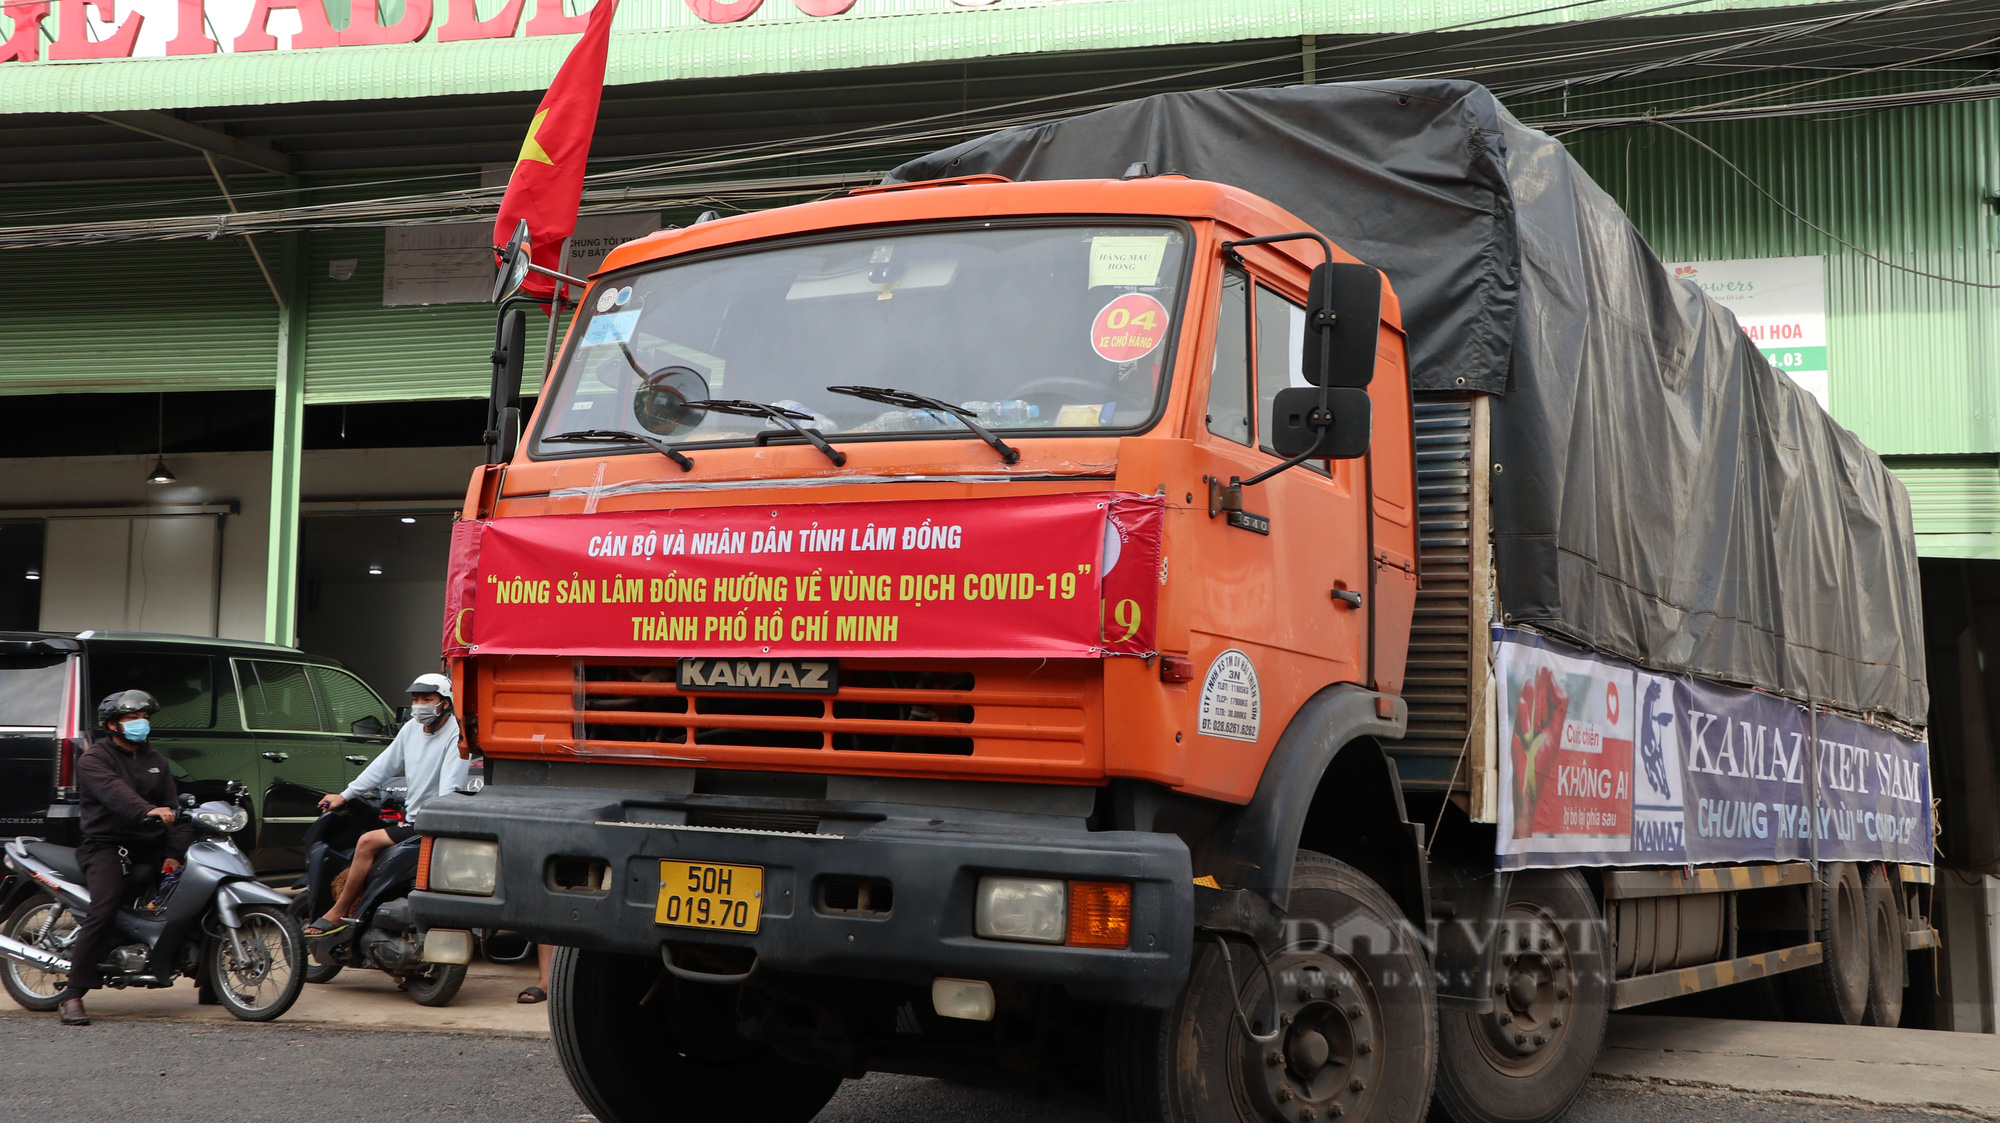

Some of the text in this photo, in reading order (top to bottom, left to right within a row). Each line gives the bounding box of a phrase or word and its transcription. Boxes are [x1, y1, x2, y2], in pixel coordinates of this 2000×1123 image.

[1107, 308, 1157, 330] 04
[1770, 324, 1802, 339] HOA
[1098, 336, 1110, 348] XE
[588, 518, 962, 561] CÁN BỘ VÀ NHÂN DÂN TỈNH LÂM ĐỒNG
[487, 574, 551, 604] “NÔNG
[555, 571, 597, 604] SẢN
[602, 573, 644, 603] LÂM
[649, 569, 707, 603] ĐỒNG
[713, 571, 788, 602] HƯỚNG
[795, 567, 822, 602] VỀ
[830, 569, 892, 602] VÙNG
[899, 574, 955, 607] DỊCH
[631, 606, 899, 642] THÀNH PHỐ HỒ CHÍ MINH
[681, 660, 831, 689] KAMAZ
[1228, 670, 1241, 680] 3N
[1203, 695, 1211, 713] CTY
[1213, 720, 1256, 736] 028.6261.6262
[1688, 710, 1922, 803] KAMAZ VIET NAM
[1558, 759, 1628, 800] KHÔNG AI
[1601, 812, 1617, 827] sau
[1698, 798, 1769, 839] CHUNG
[1773, 803, 1798, 839] TAY
[1833, 801, 1856, 841] LÙI
[1635, 819, 1686, 852] KAMAZ
[688, 866, 733, 895] 50H
[667, 895, 748, 927] 019.70
